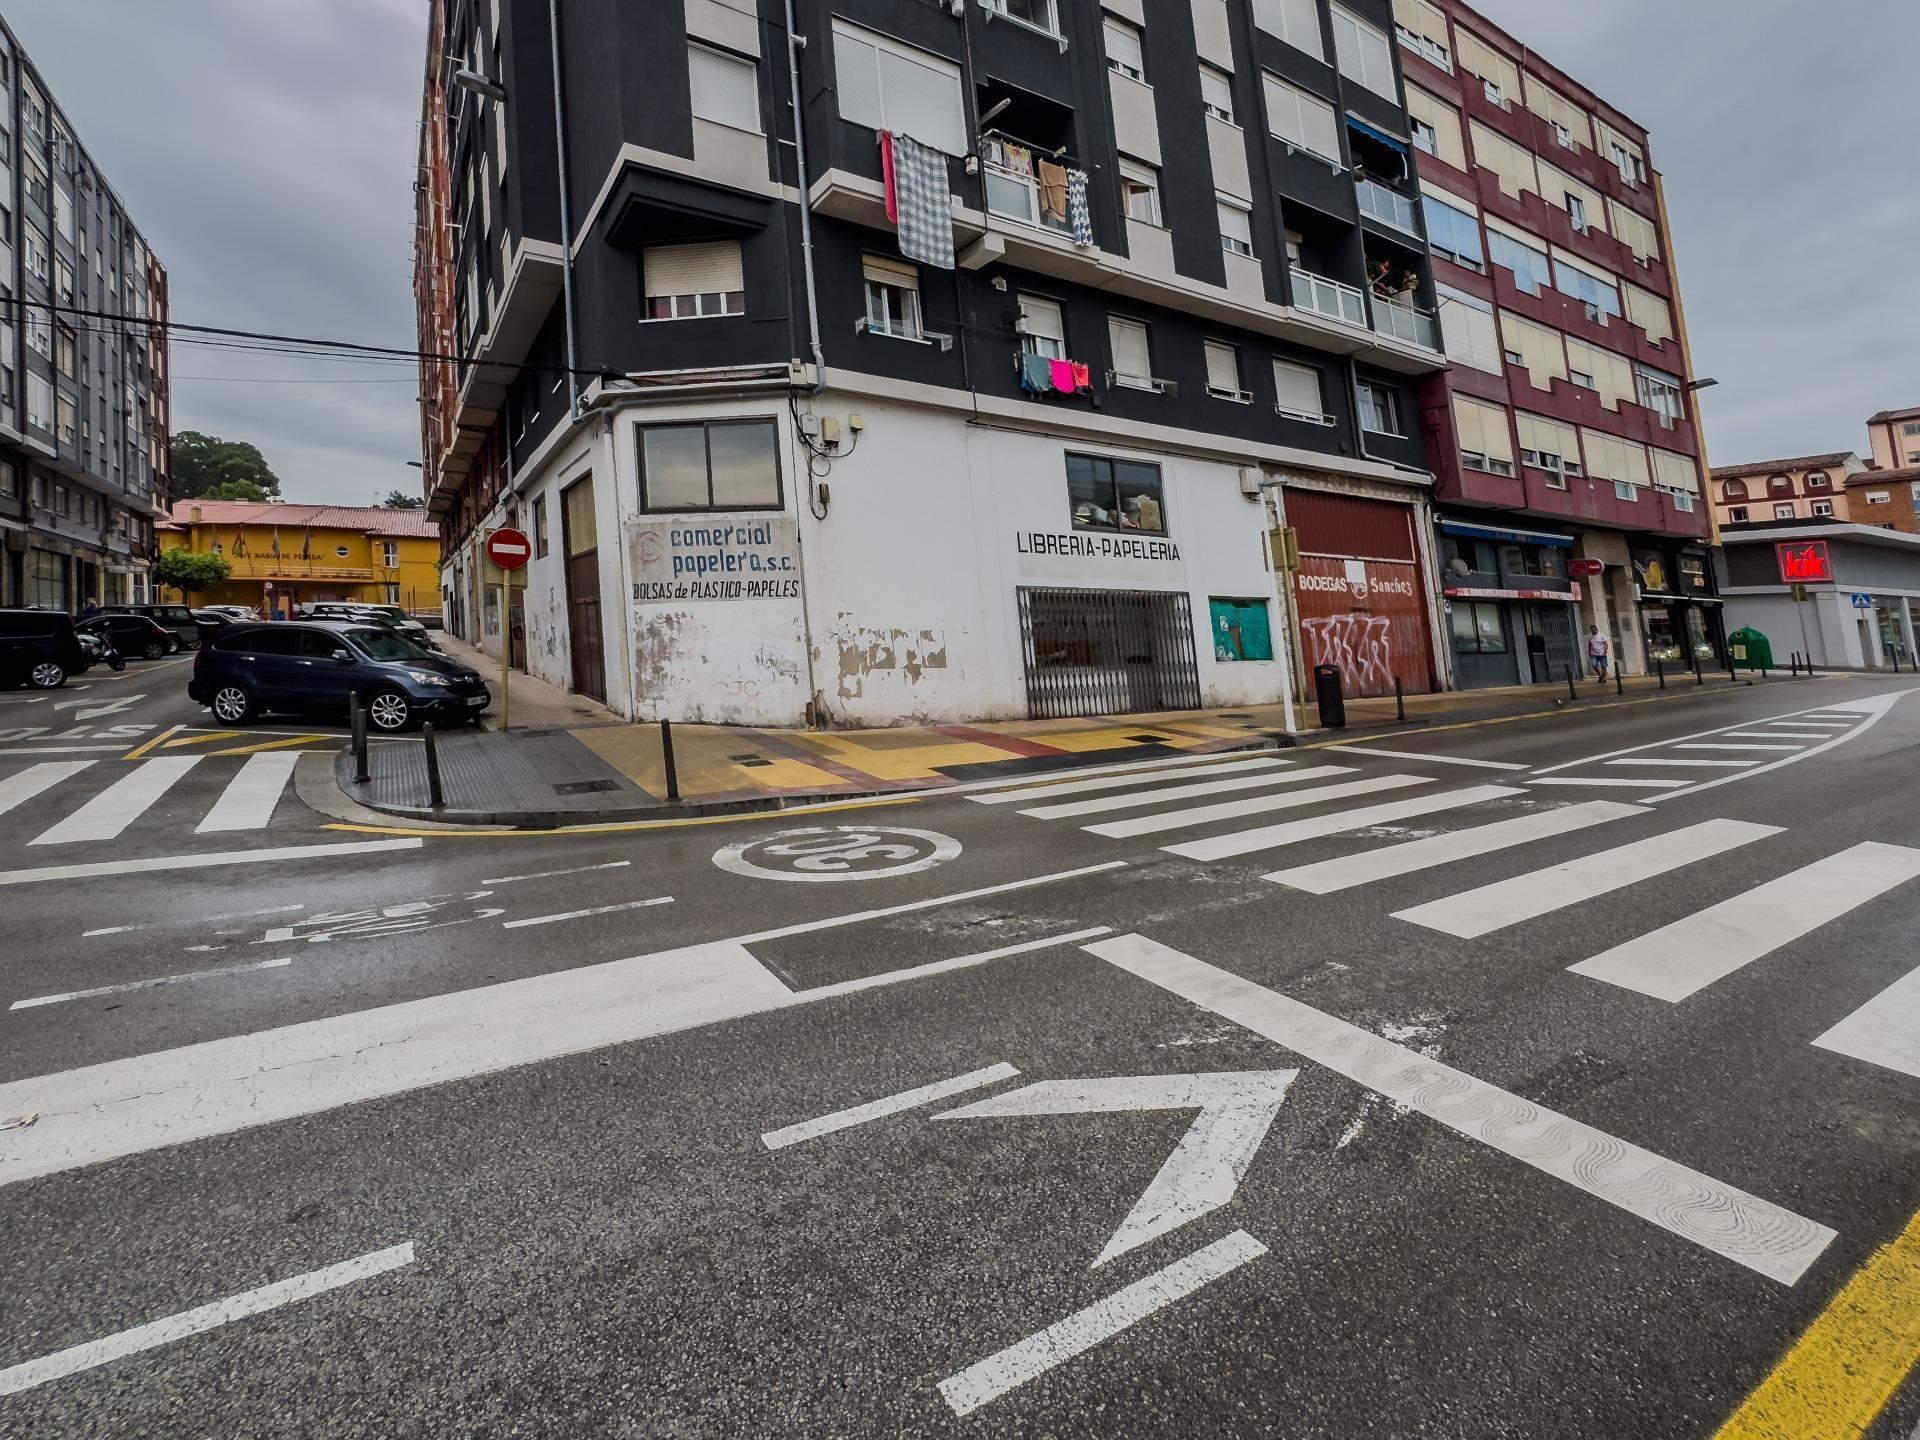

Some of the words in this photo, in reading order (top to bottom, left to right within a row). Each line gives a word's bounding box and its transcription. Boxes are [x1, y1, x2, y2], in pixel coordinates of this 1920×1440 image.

[671, 521, 772, 547] comercial
[1016, 532, 1181, 561] LIBRERIA-PAPELERIA
[1786, 547, 1824, 577] kik
[633, 582, 673, 600] BOLSAS
[674, 582, 688, 599] de
[690, 580, 799, 599] PLASTICO-PAPELES
[1298, 574, 1348, 593] BODEGAS
